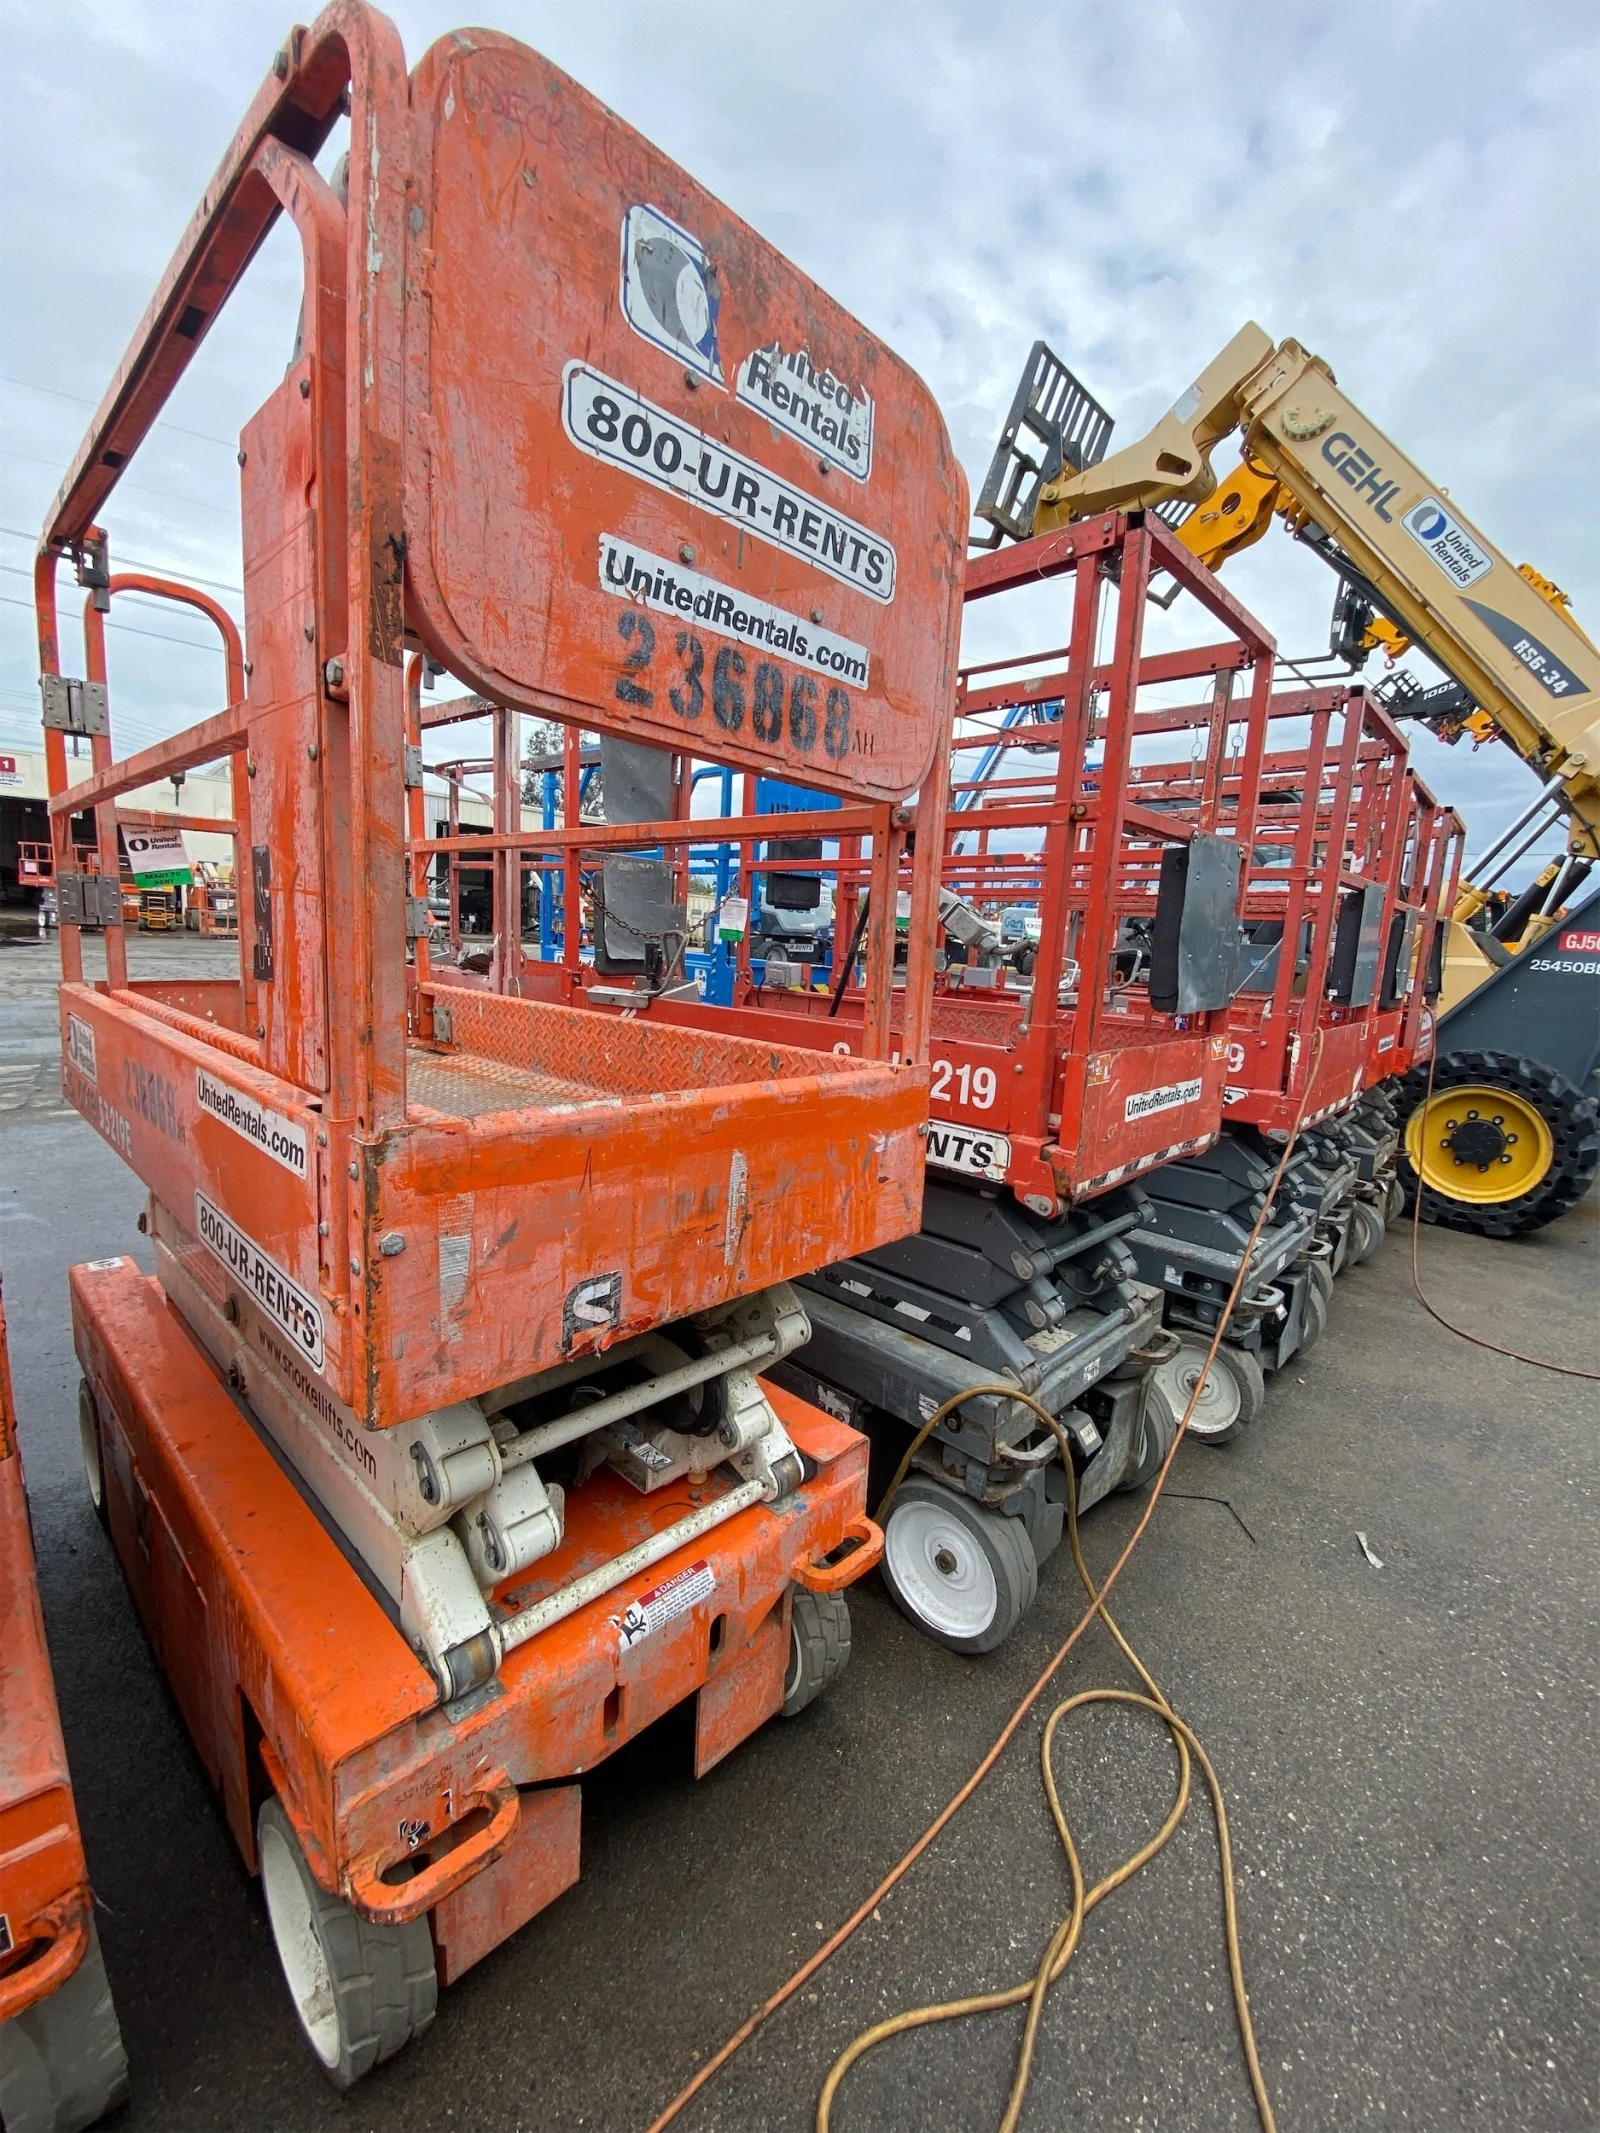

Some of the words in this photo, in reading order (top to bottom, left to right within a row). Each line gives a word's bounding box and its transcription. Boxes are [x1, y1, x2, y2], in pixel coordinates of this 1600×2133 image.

[747, 352, 861, 461] Rentals
[586, 395, 886, 585] 800-UR-RENTS
[1321, 431, 1401, 524] GEHL
[1431, 540, 1471, 583] Rentals
[1444, 530, 1484, 570] United
[605, 547, 867, 682] UnitedRentals.com
[615, 611, 850, 760] 236868
[1513, 638, 1569, 695] RS6-34
[151, 842, 182, 850] Rentals
[197, 1075, 305, 1170] UnitedRentals.com
[199, 1205, 316, 1350] 800-UR-RENTS
[258, 1325, 377, 1480] www.snorkellifts.com
[659, 1567, 697, 1594] DANGER
